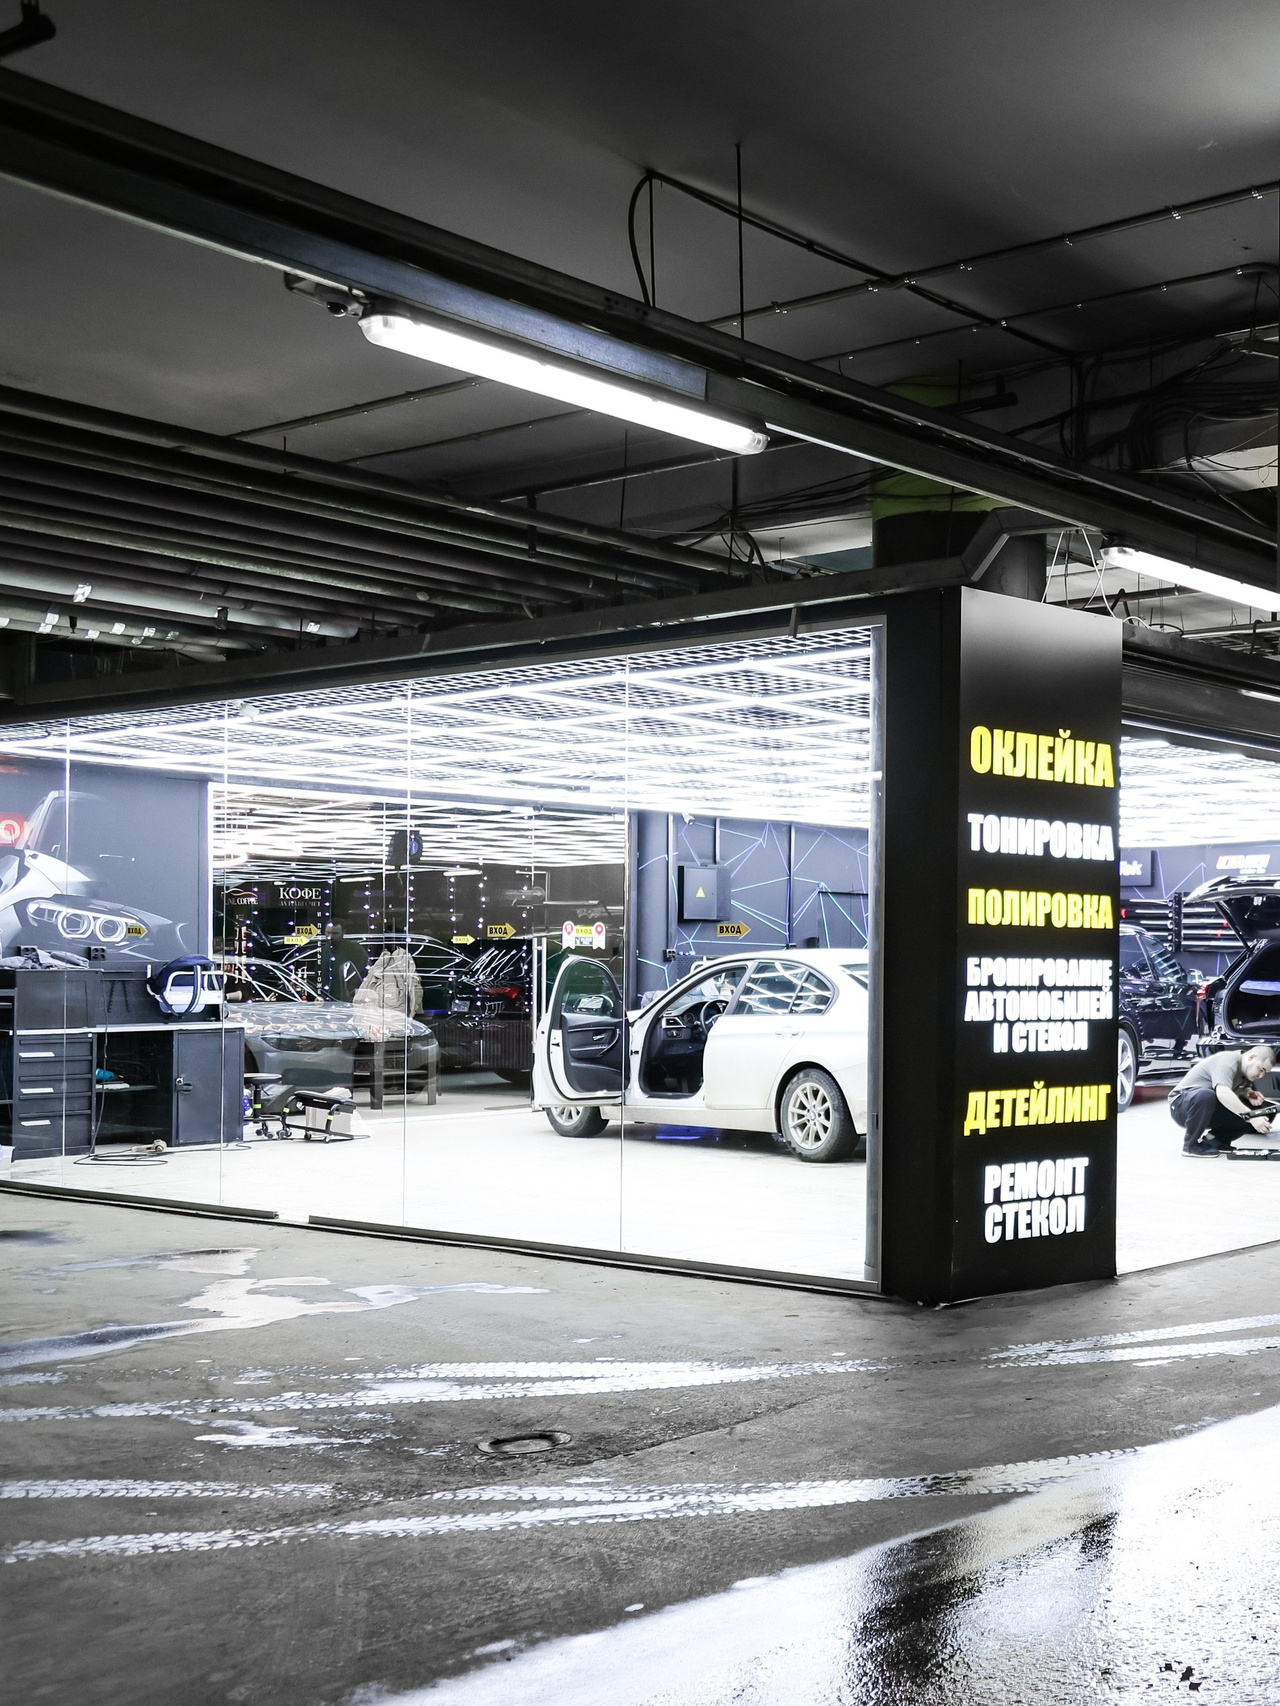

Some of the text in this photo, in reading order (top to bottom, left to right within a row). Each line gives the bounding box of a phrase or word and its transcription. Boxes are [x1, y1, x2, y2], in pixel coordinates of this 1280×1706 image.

[969, 727, 1115, 788] ОКЛЕЙКА
[967, 814, 1115, 861] ТОНИРОВКА
[279, 887, 322, 900] КОФЕ
[967, 888, 1114, 929] ПОЛИРОВКА
[489, 926, 507, 936] ВХОД
[719, 925, 742, 934] ВХОД
[966, 957, 1113, 988] БРОНИРОВАНИЕ
[963, 985, 1113, 1023] АВТОМОБИЛЕЙ
[993, 1022, 1089, 1053] И СТЕКОЛ
[963, 1081, 1112, 1137] ДЕТЕЙЛИНГ
[983, 1157, 1089, 1206] РЕМОНТ
[983, 1195, 1087, 1245] СТЕКОЛ
